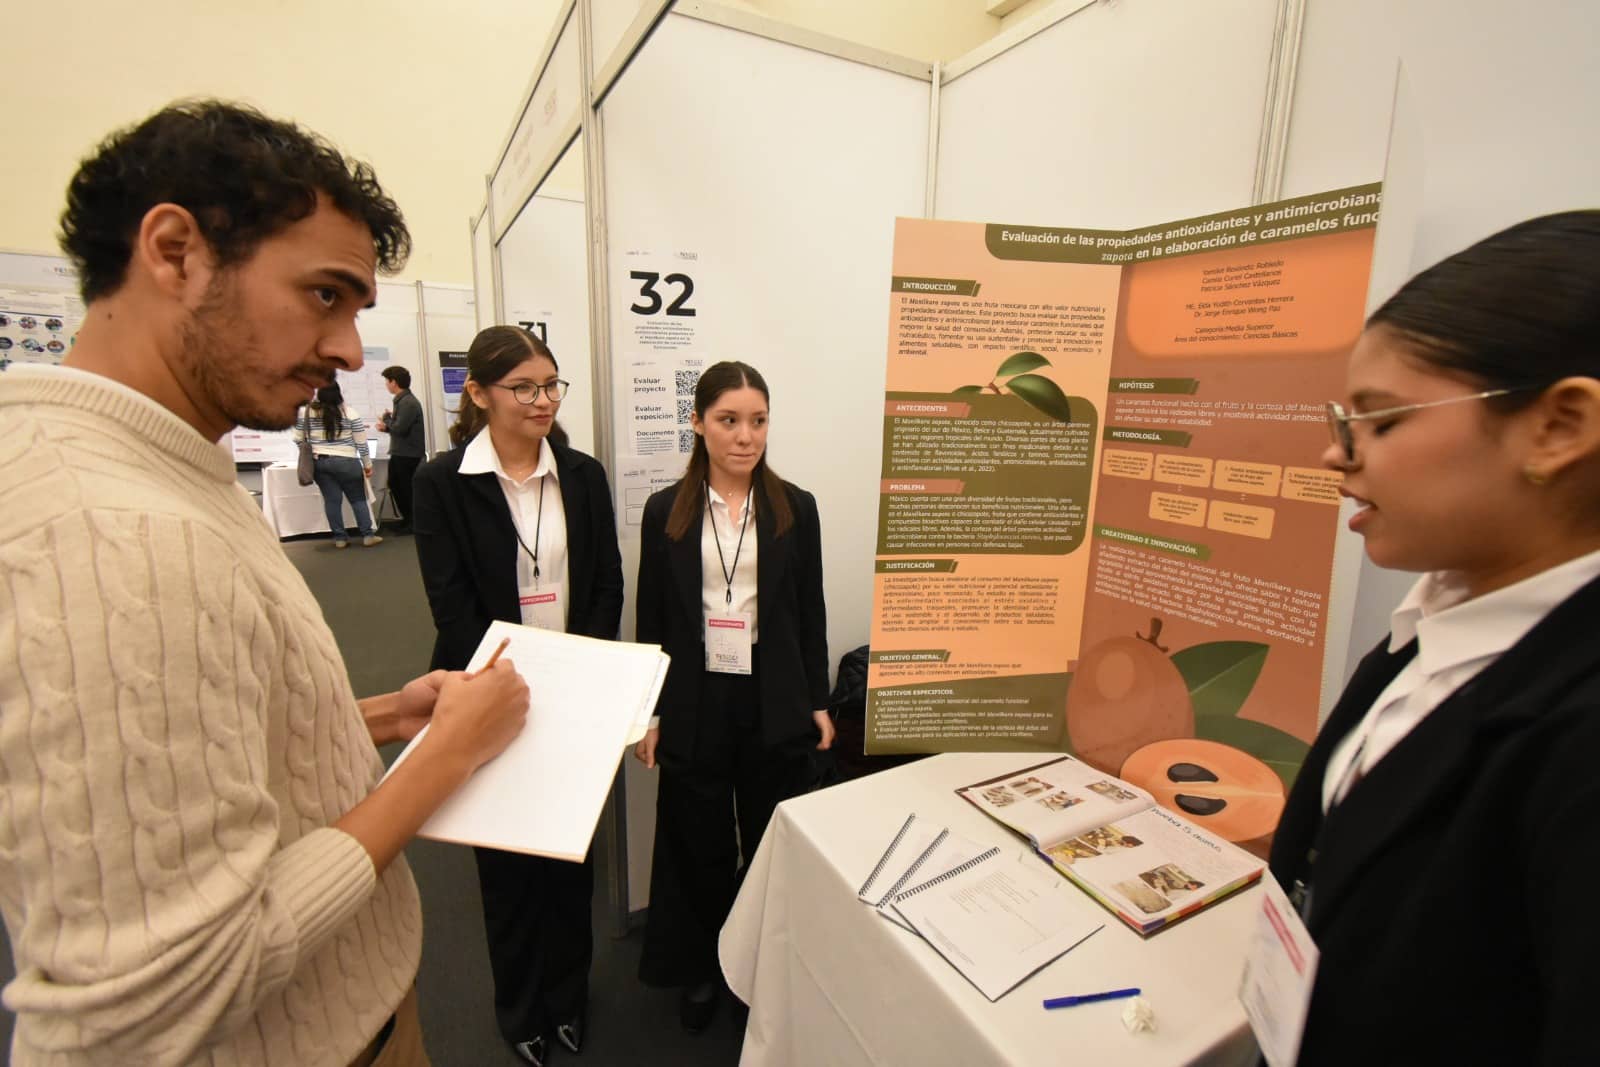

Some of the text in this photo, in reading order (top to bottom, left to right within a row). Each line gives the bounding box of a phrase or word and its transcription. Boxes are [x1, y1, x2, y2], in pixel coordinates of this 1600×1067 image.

[1001, 230, 1060, 244] Evaluación
[1063, 234, 1076, 244] de
[1080, 235, 1094, 245] las
[1096, 232, 1163, 248] propiedades
[1166, 216, 1250, 240] antioxidantes
[1254, 214, 1262, 226] y
[1101, 253, 1133, 263] zapota
[1136, 249, 1149, 259] en
[1153, 246, 1162, 256] la
[1166, 234, 1235, 255] elaboración
[1240, 229, 1256, 242] de
[1260, 219, 1338, 239] caramelos
[630, 270, 696, 316] 32
[903, 282, 956, 291] INTRODUCCIÓN
[1112, 431, 1162, 440] METODOLOGÍA.
[1101, 529, 1143, 543] CREATIVIDAD
[1151, 539, 1198, 554] INNOVACIÓN.
[1220, 570, 1230, 578] del
[1233, 573, 1250, 582] fruto
[1294, 589, 1321, 600] zapota
[1236, 584, 1258, 593] ofrece
[1261, 590, 1281, 599] sabor
[1292, 597, 1320, 609] textura
[1268, 600, 1280, 608] del
[1283, 604, 1301, 614] fruto
[1303, 610, 1318, 618] que
[1281, 623, 1315, 637] actividad
[1290, 616, 1304, 624] con
[1265, 628, 1304, 644] aportando
